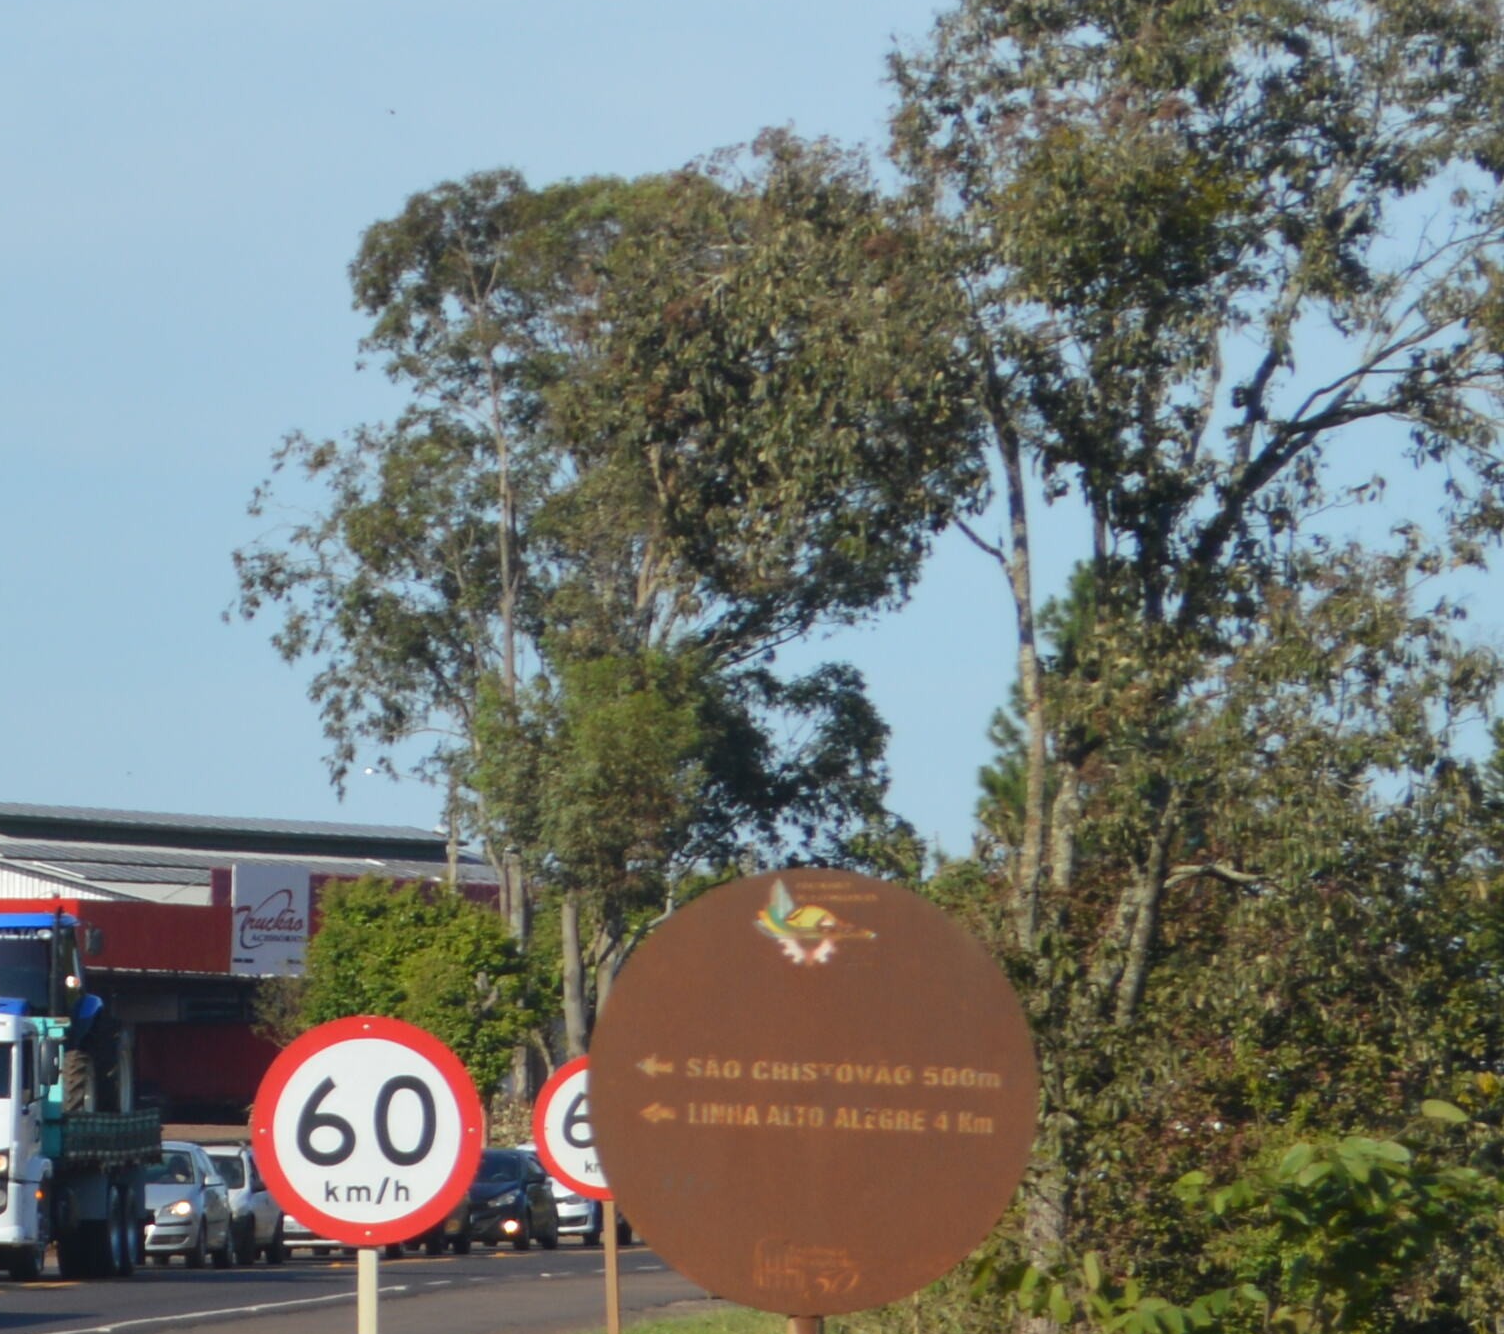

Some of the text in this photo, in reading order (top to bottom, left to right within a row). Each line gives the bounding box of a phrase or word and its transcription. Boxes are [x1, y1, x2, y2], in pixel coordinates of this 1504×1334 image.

[923, 1066, 1000, 1088] 500m
[296, 1075, 436, 1167] 60
[689, 1103, 993, 1133] LINHA ALTO ALEGRE 4 Km
[325, 1177, 410, 1205] km/h
